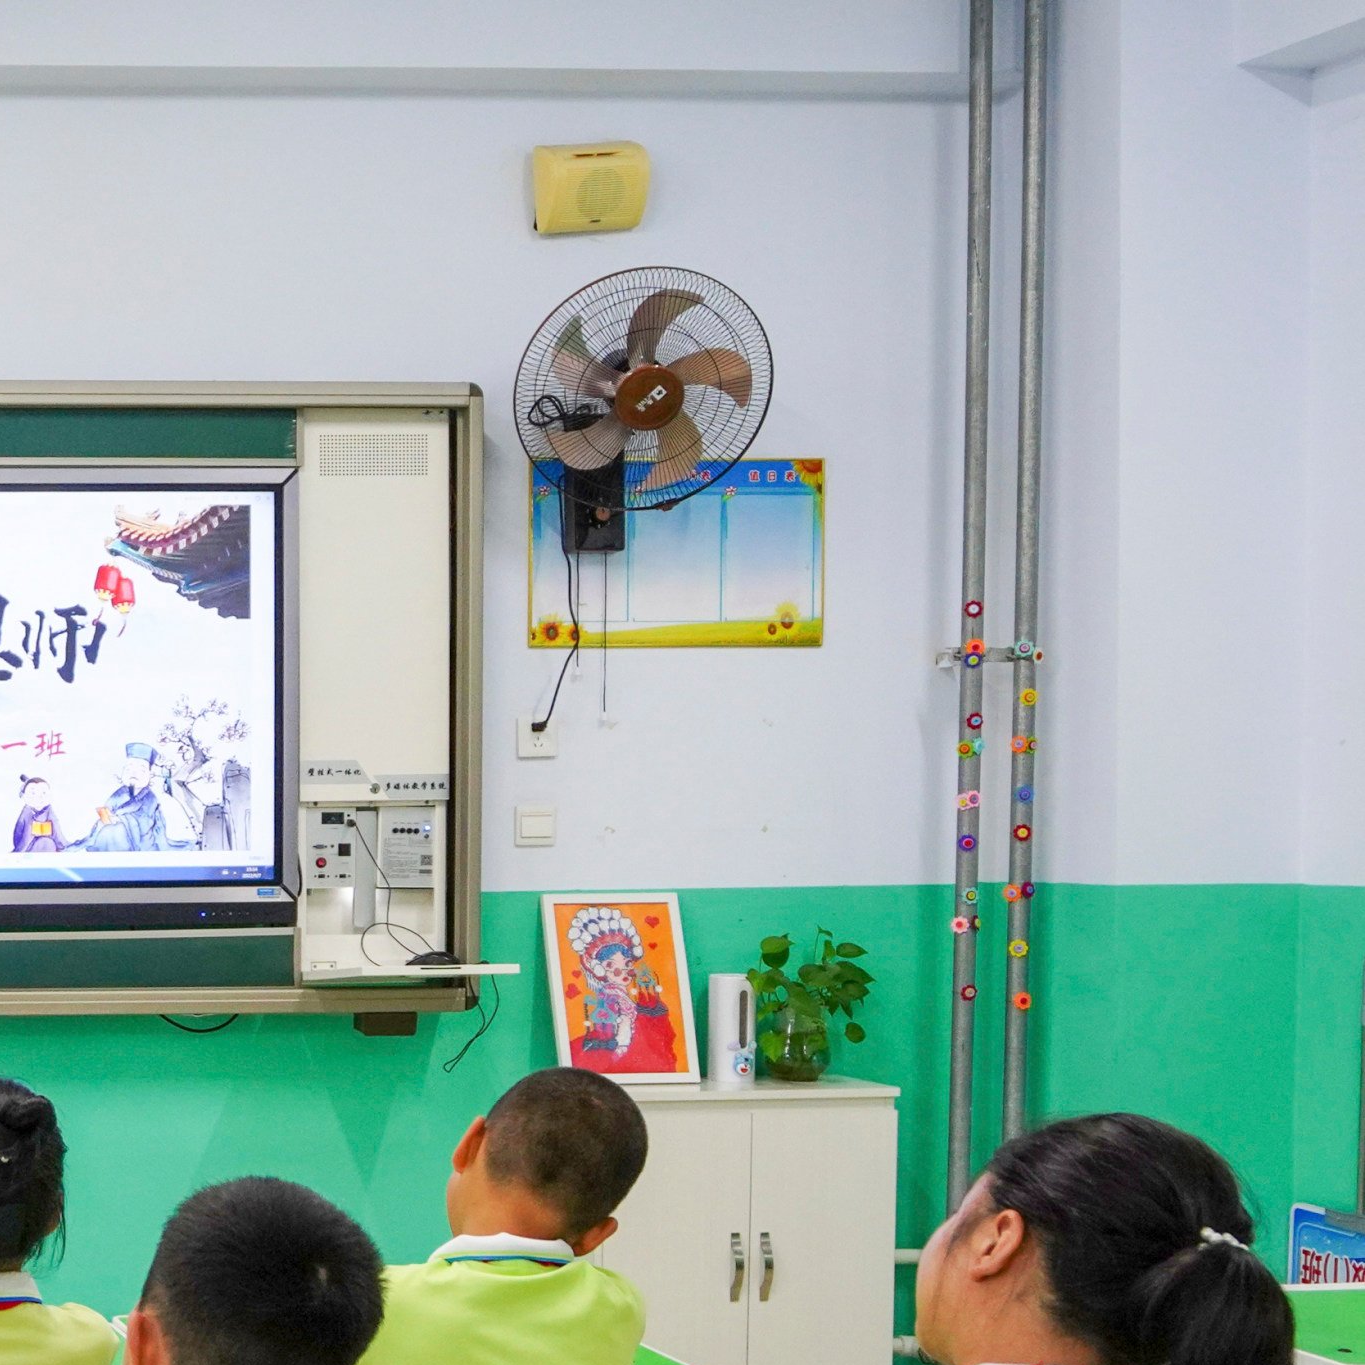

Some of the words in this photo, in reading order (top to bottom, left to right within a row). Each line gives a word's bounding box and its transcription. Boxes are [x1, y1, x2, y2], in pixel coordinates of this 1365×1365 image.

[749, 469, 797, 482] 值日表
[307, 767, 362, 777] 壁挂式一体化
[385, 782, 447, 791] 多媒体教学系统
